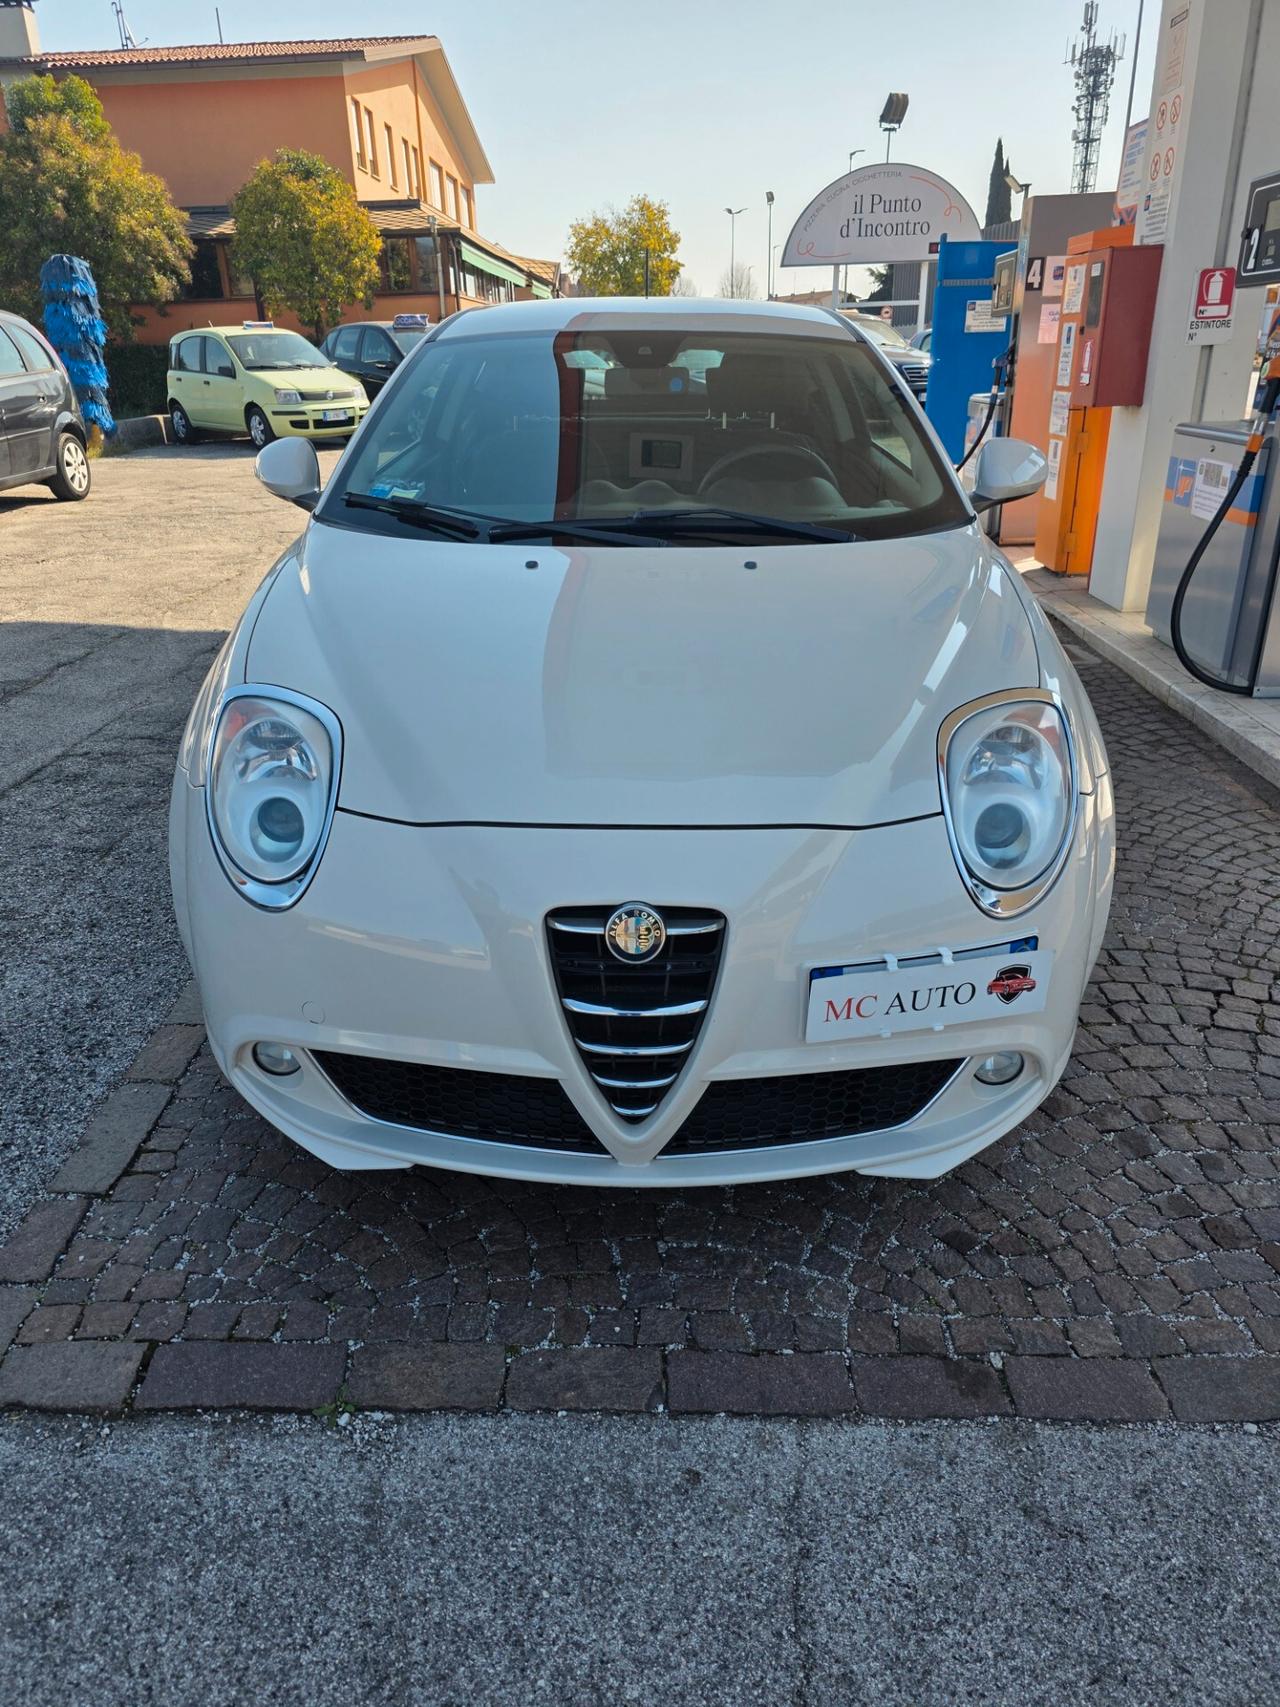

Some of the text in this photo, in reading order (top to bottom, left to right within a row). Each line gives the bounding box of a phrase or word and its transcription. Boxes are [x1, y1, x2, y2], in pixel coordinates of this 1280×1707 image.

[827, 183, 850, 203] CUCINA
[851, 171, 903, 186] CICCHETTERIA
[853, 193, 922, 214] il Punto
[1246, 228, 1260, 270] 2
[1027, 259, 1041, 288] 4
[1189, 319, 1232, 330] ESTINTORE
[609, 910, 661, 937] ALFA ROMEO
[823, 981, 977, 1023] MC AUTO
